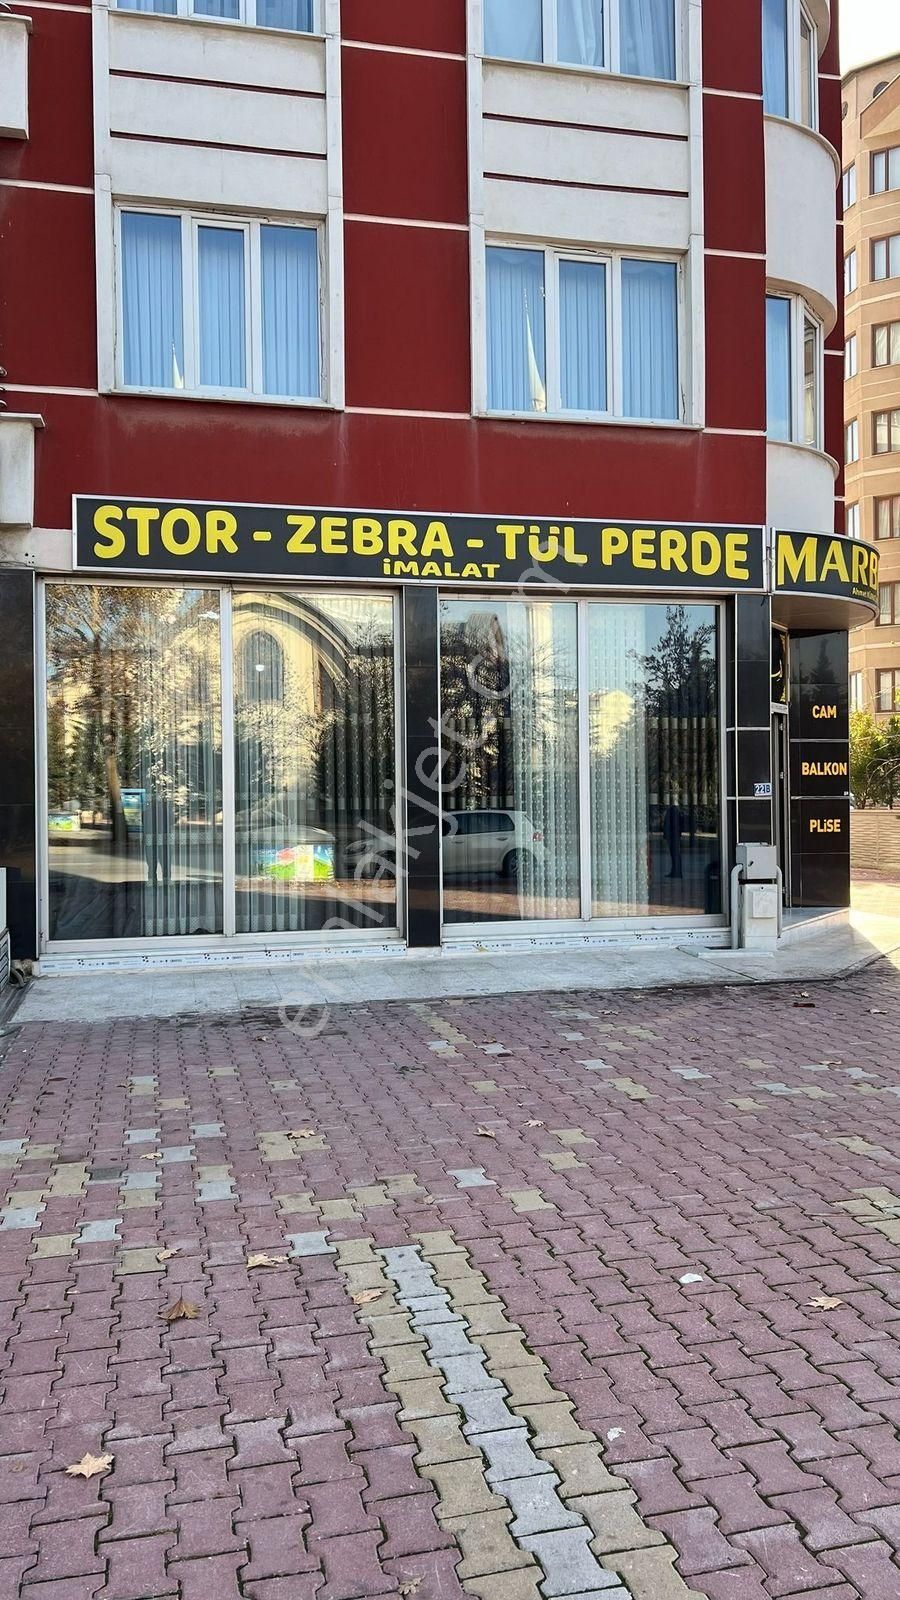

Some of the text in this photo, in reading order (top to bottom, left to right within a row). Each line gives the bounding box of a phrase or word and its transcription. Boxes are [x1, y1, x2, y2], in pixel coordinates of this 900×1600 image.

[93, 504, 750, 581] STOR - ZEBRA - TÜL PERDE
[812, 704, 837, 718] CAM
[802, 762, 848, 775] BALKON
